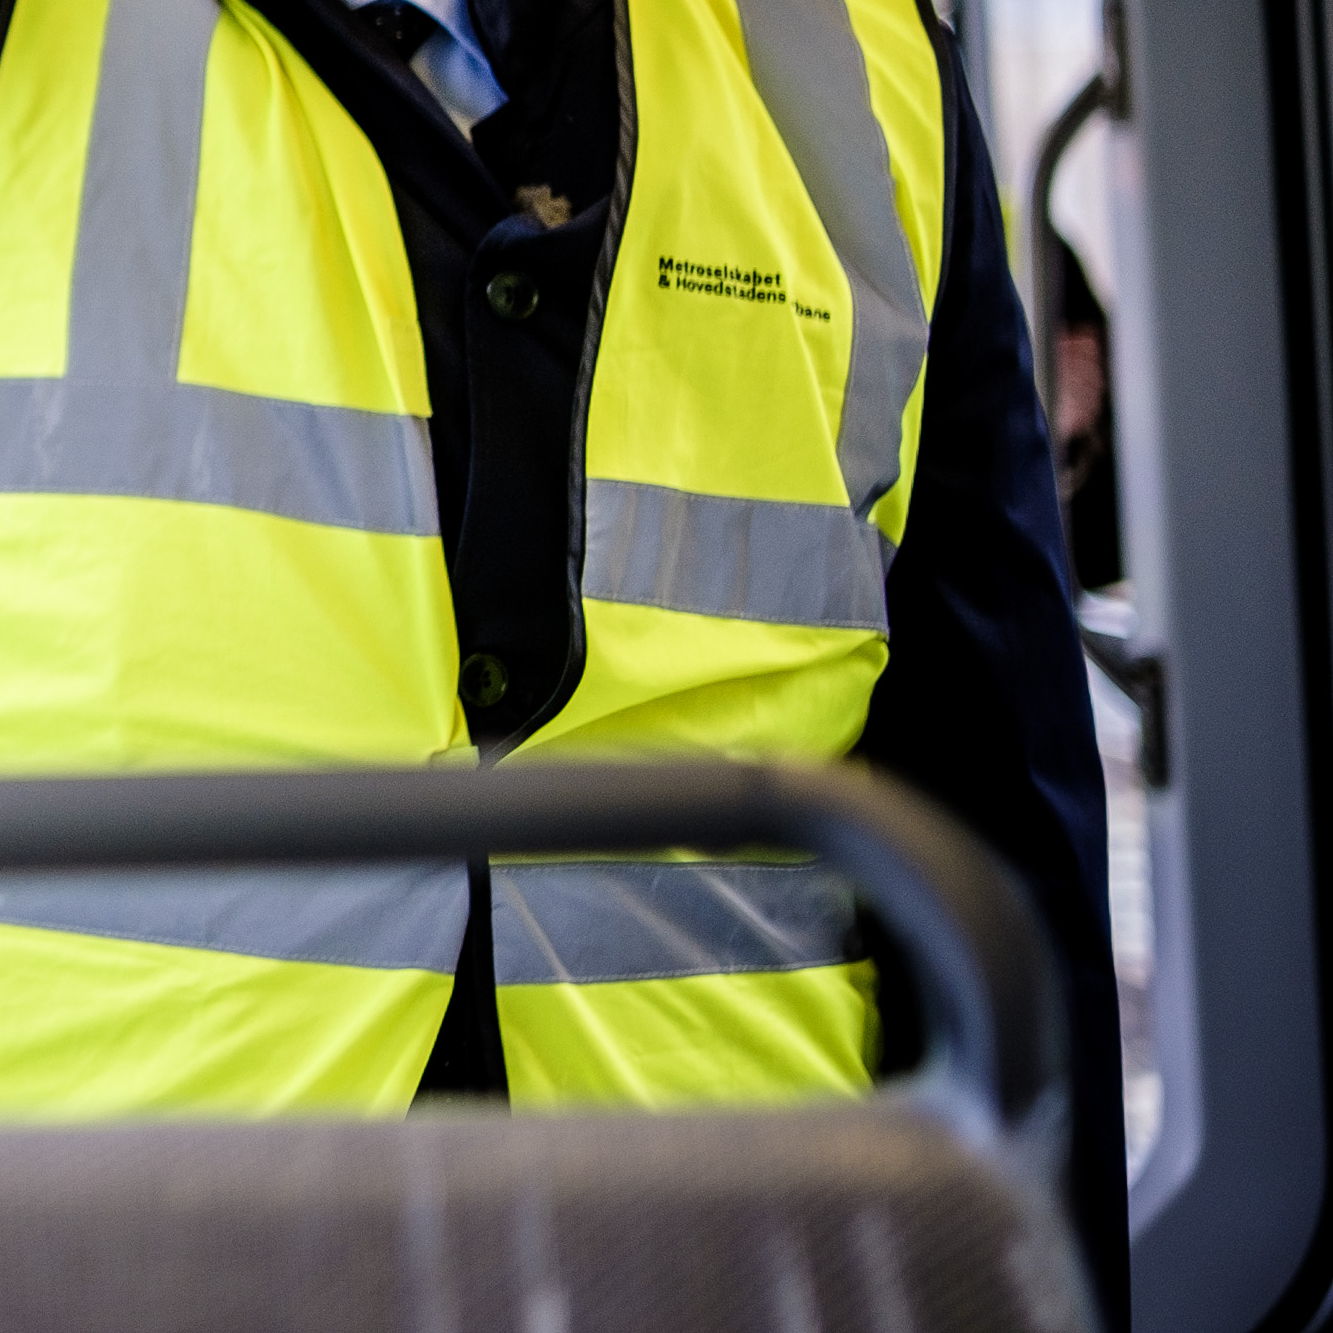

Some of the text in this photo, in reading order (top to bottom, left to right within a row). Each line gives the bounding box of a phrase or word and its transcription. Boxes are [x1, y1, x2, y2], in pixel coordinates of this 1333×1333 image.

[658, 257, 781, 287] Metroselskabet
[658, 274, 671, 289] &
[676, 276, 786, 303] Hovedstadens
